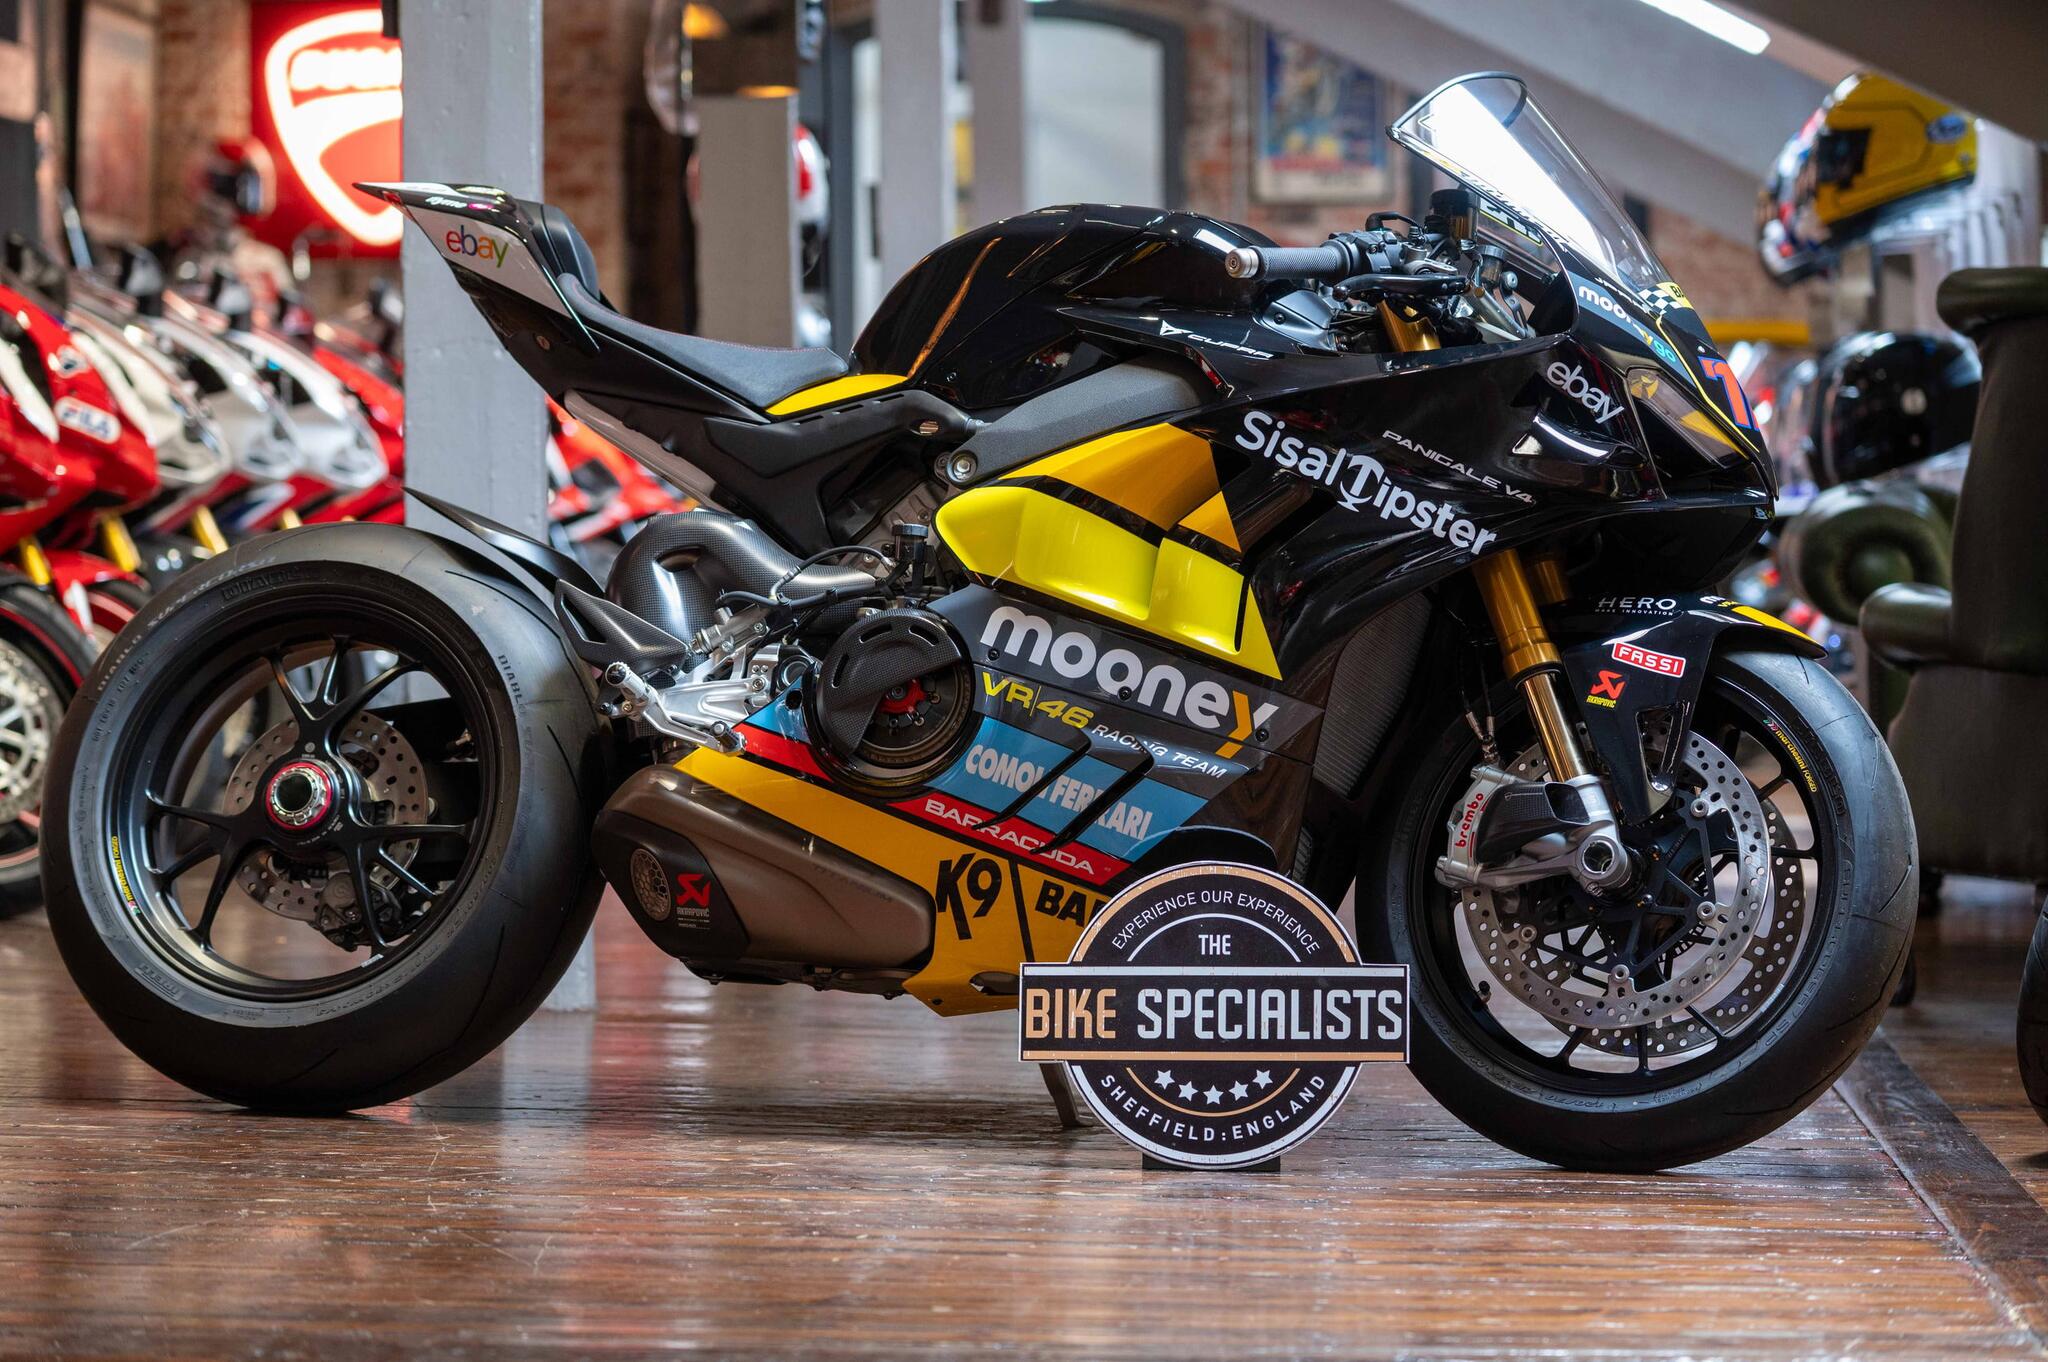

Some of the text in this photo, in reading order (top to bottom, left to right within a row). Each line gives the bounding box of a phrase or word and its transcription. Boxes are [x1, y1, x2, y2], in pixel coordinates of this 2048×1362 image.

[446, 224, 510, 268] ebay
[1546, 361, 1625, 424] ebay
[1382, 429, 1502, 490] PANIGALE
[1598, 596, 1677, 610] HERO
[1622, 608, 1674, 616] INNOVATION
[979, 605, 1280, 759] mooney
[1617, 646, 1681, 674] FASSI
[1172, 751, 1228, 779] TEAM
[1455, 792, 1484, 848] brembo
[935, 852, 1003, 940] K9
[1111, 890, 1320, 954] EXPERIENCE OUR EXPERIENCE
[1198, 934, 1231, 956] THE
[1025, 988, 1117, 1039] BIKE
[1137, 988, 1403, 1040] SPECIALISTS
